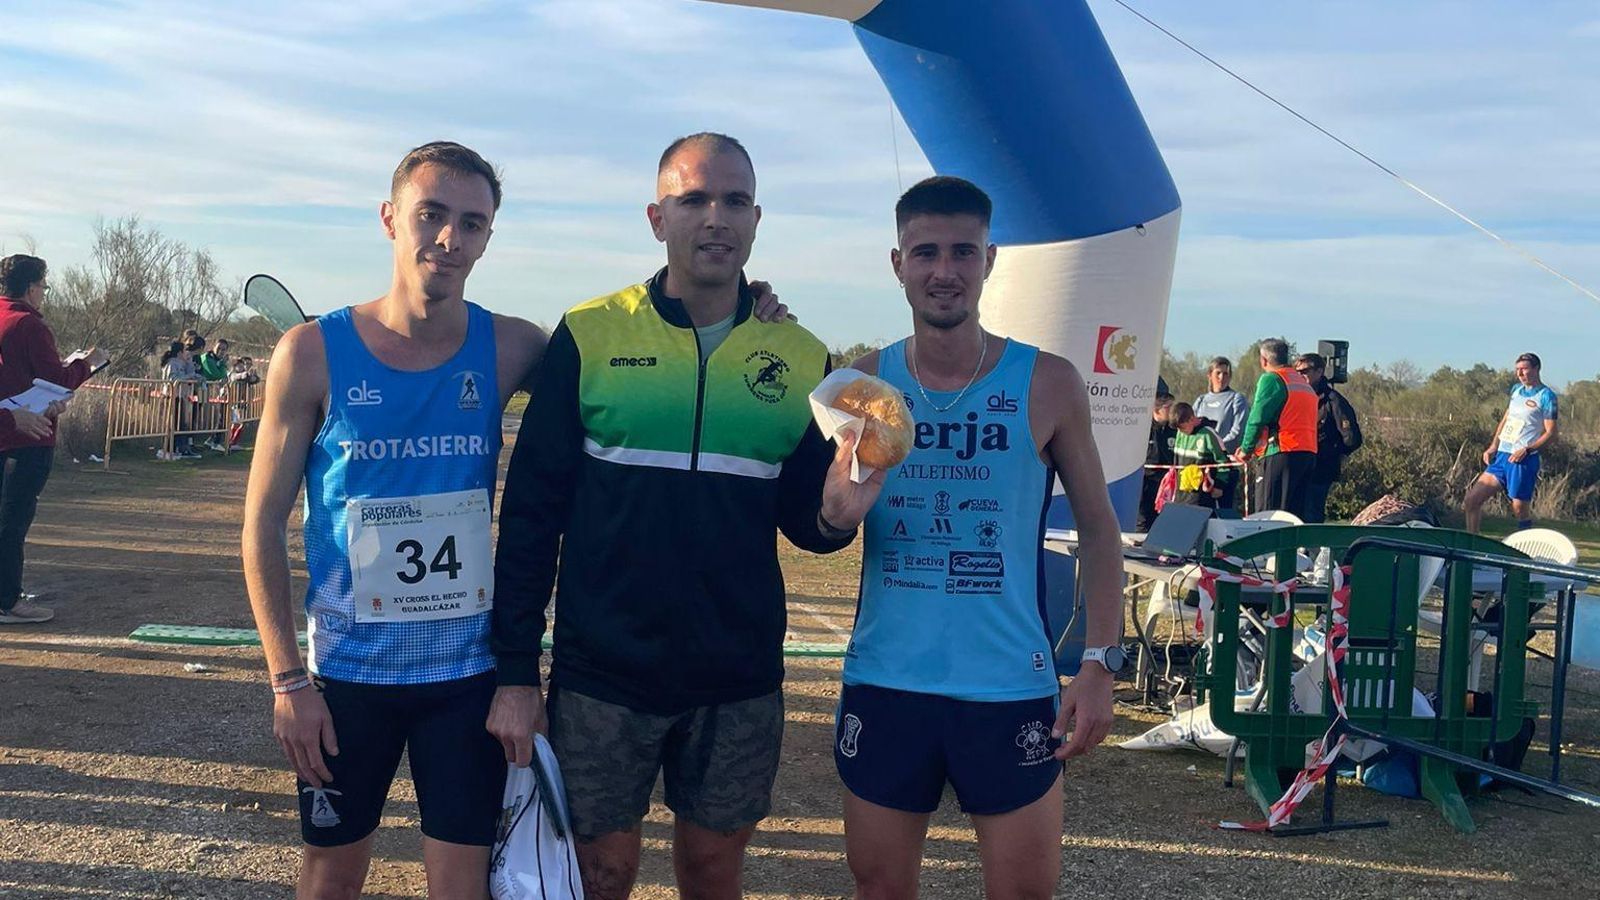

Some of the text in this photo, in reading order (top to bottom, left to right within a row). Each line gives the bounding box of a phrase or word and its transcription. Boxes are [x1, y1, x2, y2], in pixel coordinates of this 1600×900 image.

[745, 350, 791, 372] CLUB ATLETISMO
[347, 379, 383, 406] als
[1087, 381, 1109, 397] ión
[1112, 384, 1129, 398] de
[986, 389, 1019, 413] als
[1092, 403, 1106, 412] ión
[1108, 404, 1120, 413] de
[1092, 416, 1122, 426] tección
[914, 411, 1010, 460] erja
[898, 463, 990, 481] ATLETISMO
[361, 503, 412, 515] carreras
[971, 498, 999, 506] CUEVA
[361, 509, 423, 523] populares
[395, 535, 463, 584] 34
[915, 555, 945, 567] activa
[953, 555, 1002, 571] Rogelio
[393, 591, 468, 604] XV CROSS EL HECHO
[401, 602, 461, 613] GUADALCÁZAR
